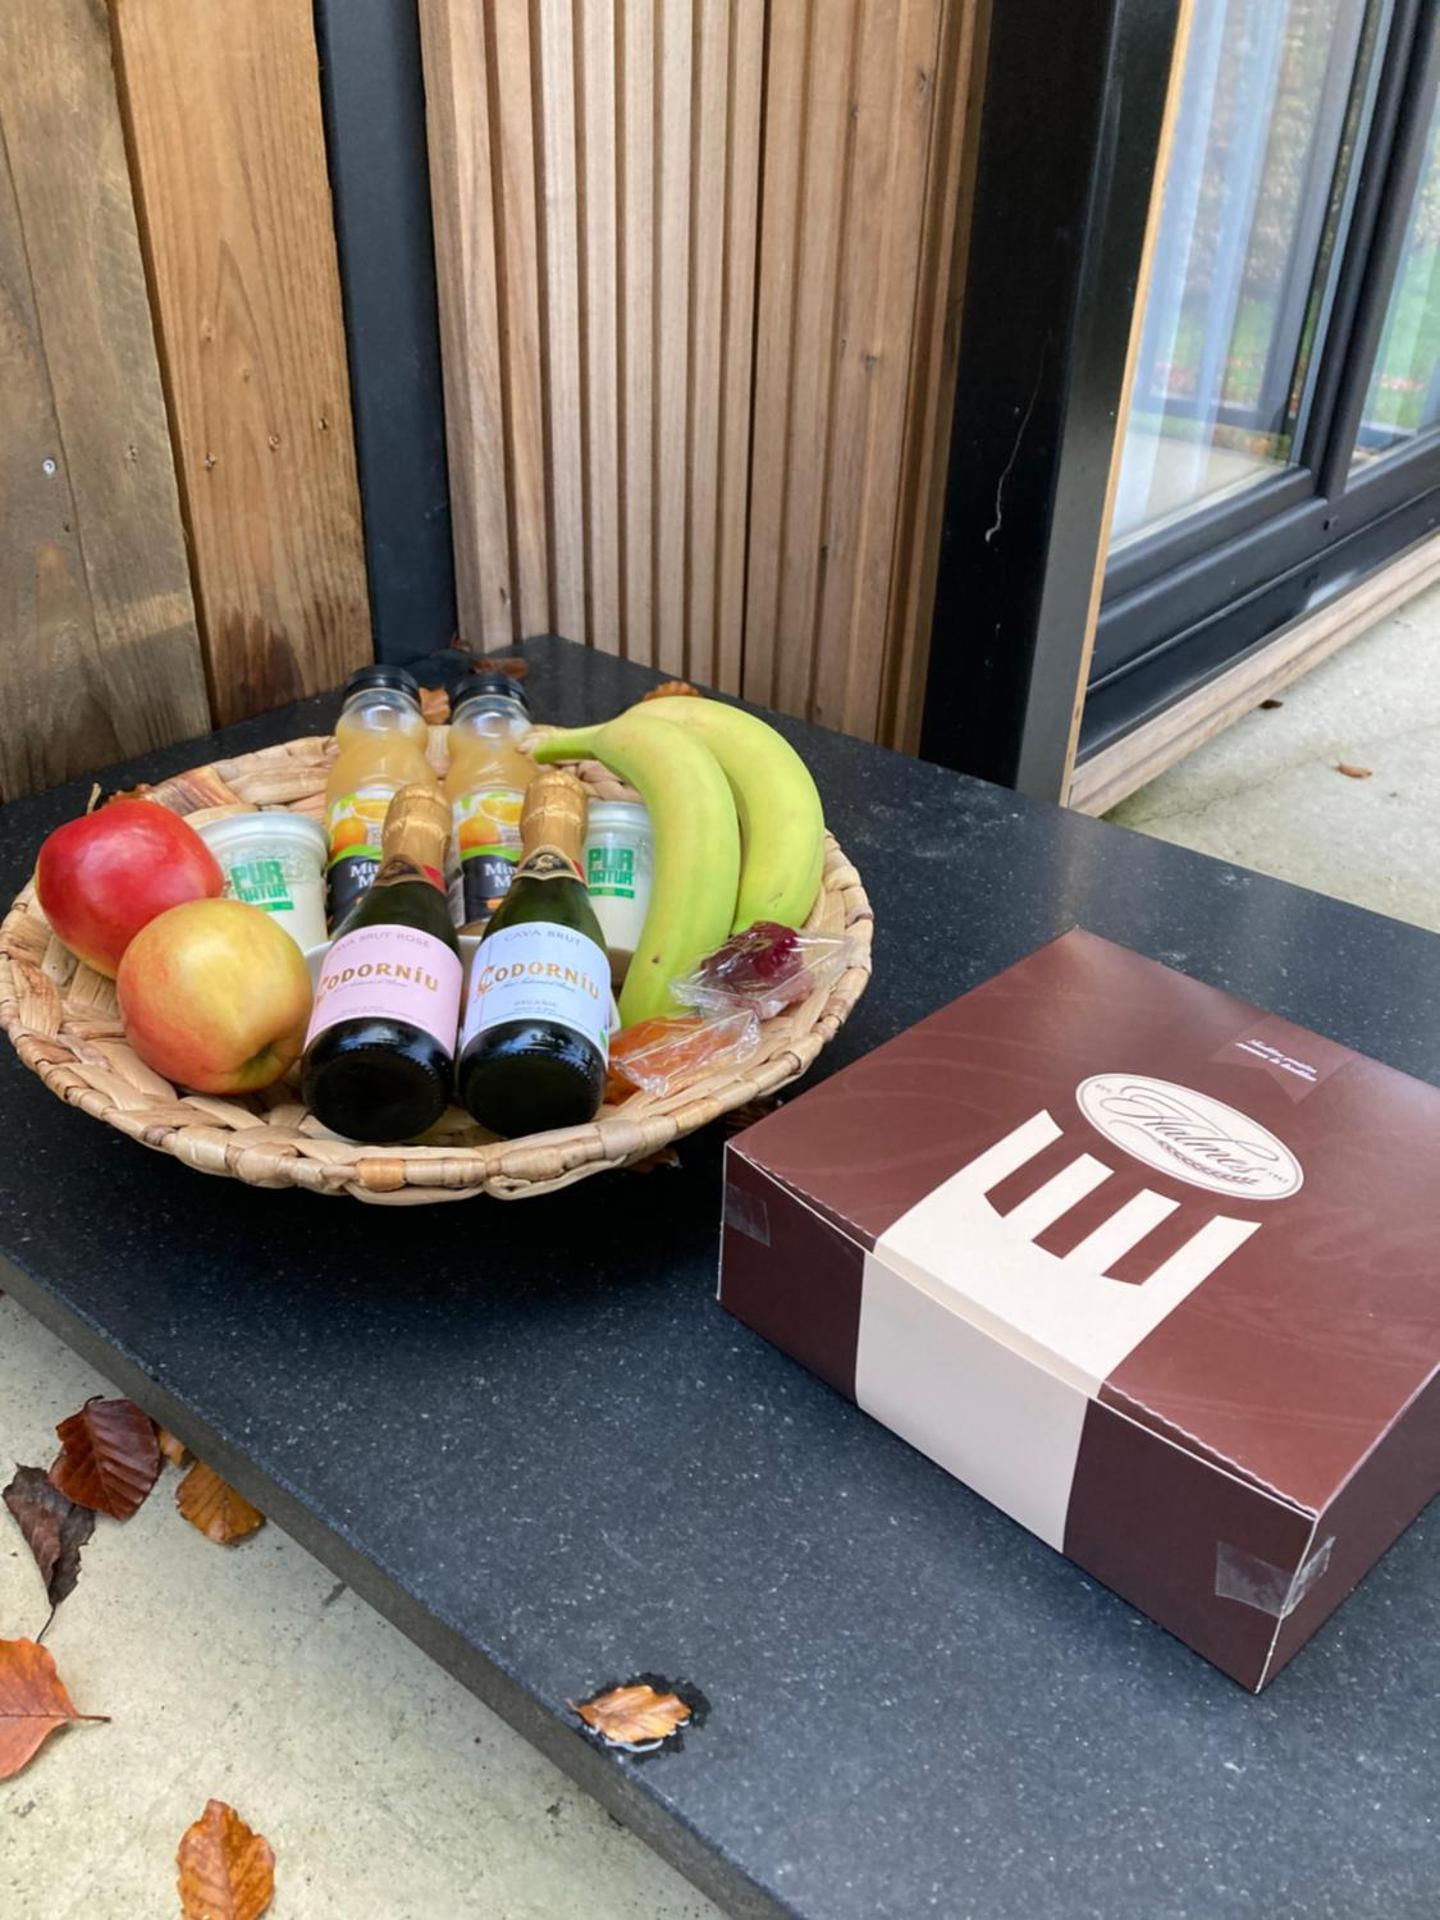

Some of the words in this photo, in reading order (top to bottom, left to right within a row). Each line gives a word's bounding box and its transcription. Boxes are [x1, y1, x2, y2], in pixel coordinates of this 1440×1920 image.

[588, 848, 633, 871] PUR
[230, 861, 285, 890] PUR
[588, 870, 632, 886] NATUR
[237, 884, 289, 902] NATUR
[503, 928, 543, 943] CAVA
[547, 930, 582, 946] BRUT
